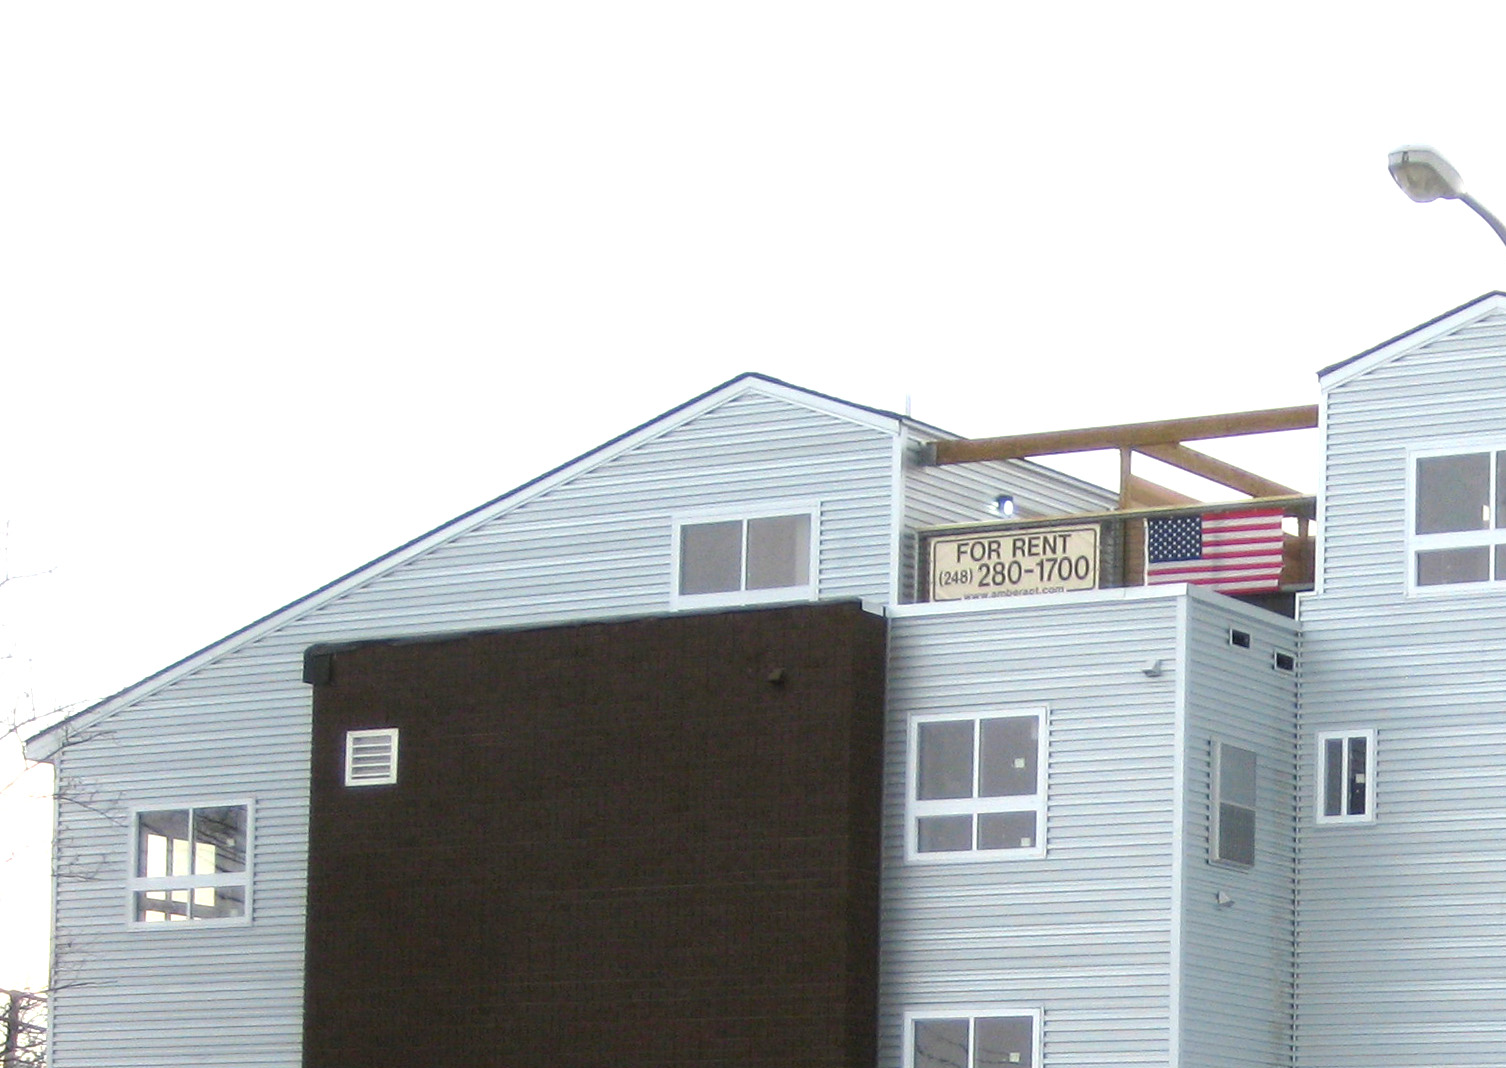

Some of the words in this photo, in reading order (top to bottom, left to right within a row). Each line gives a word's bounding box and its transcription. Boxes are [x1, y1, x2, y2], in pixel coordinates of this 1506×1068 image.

[957, 540, 1001, 563] FOR
[1012, 534, 1072, 558] RENT
[939, 568, 973, 587] (248)
[978, 555, 1090, 588] 280-1700
